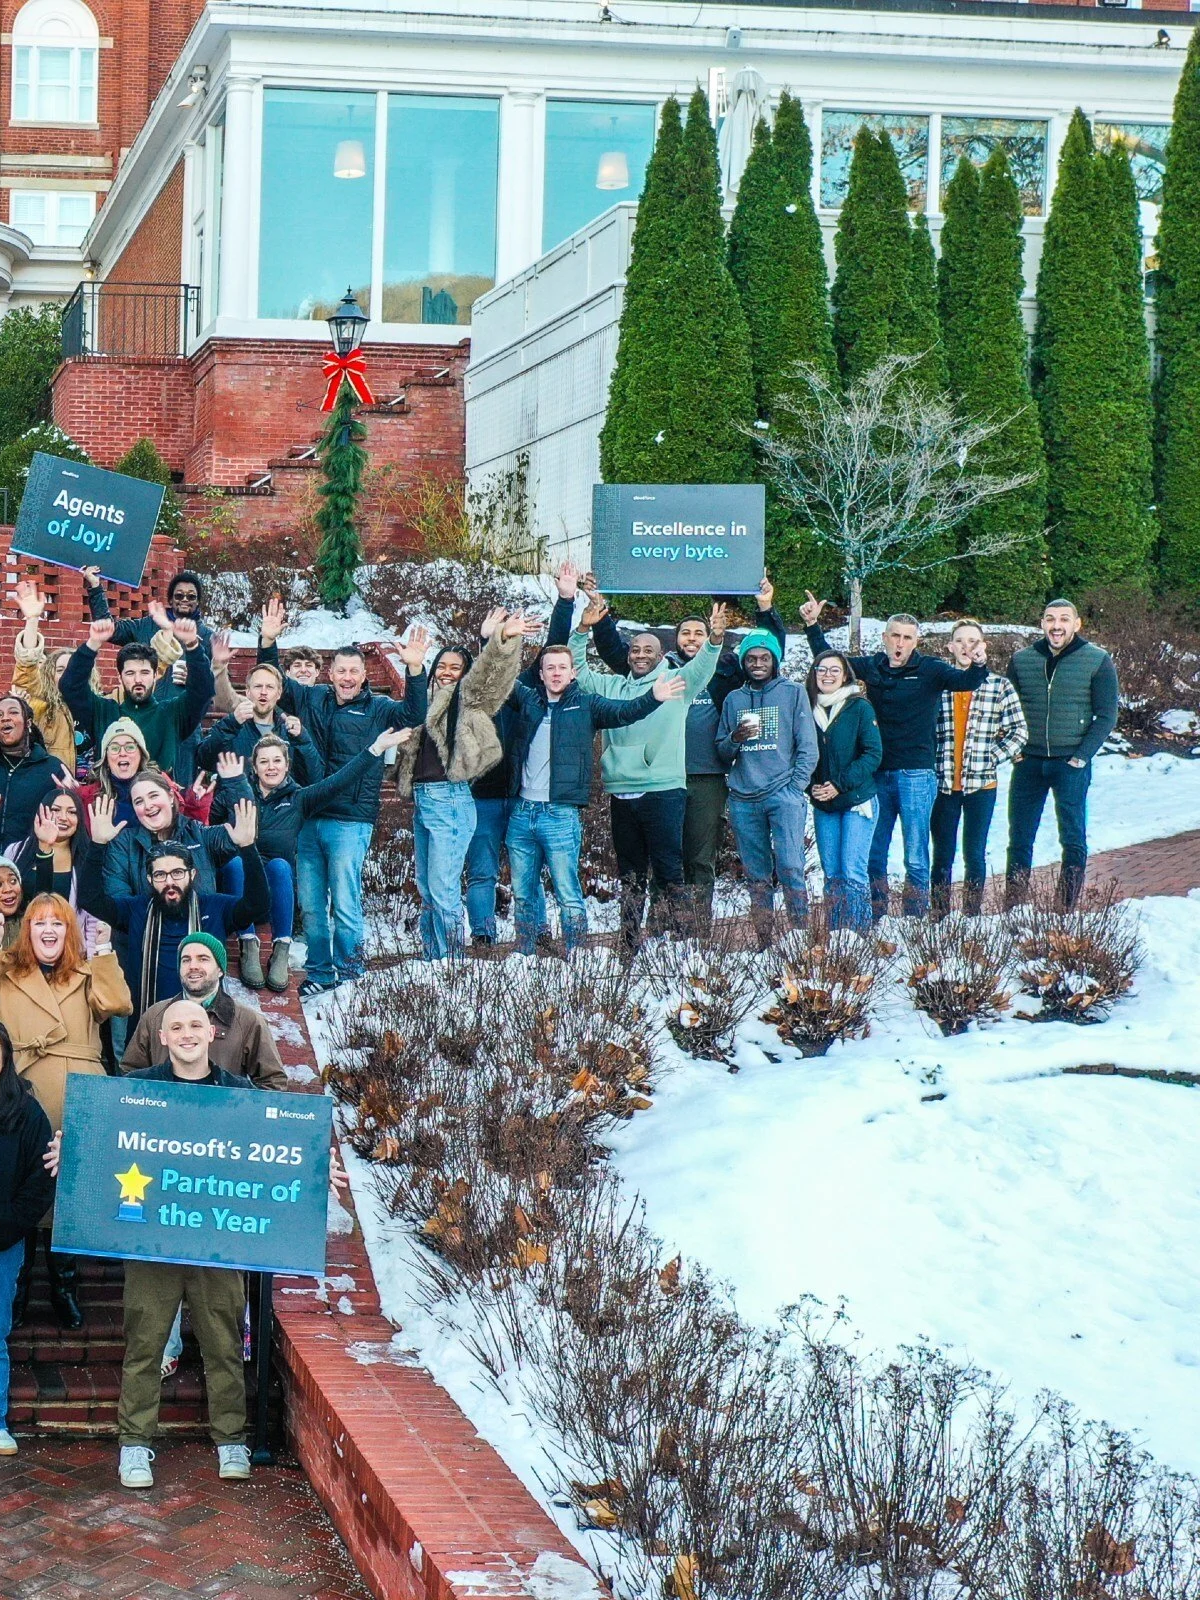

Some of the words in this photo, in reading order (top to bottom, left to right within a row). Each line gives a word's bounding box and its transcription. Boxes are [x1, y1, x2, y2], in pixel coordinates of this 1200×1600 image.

[52, 489, 125, 525] Agents
[47, 519, 71, 538] of
[71, 523, 115, 553] Joy!
[632, 521, 726, 536] Excellence
[730, 520, 747, 536] in
[631, 546, 681, 561] every
[685, 543, 729, 562] byte.
[690, 697, 713, 706] force
[120, 1095, 168, 1108] cloudforce
[279, 1109, 316, 1121] Microsoft
[117, 1130, 242, 1160] Microsoft's
[247, 1142, 303, 1165] 2025
[161, 1168, 264, 1199] Partner
[271, 1179, 301, 1203] of
[158, 1202, 203, 1228] the
[211, 1207, 271, 1235] Year
